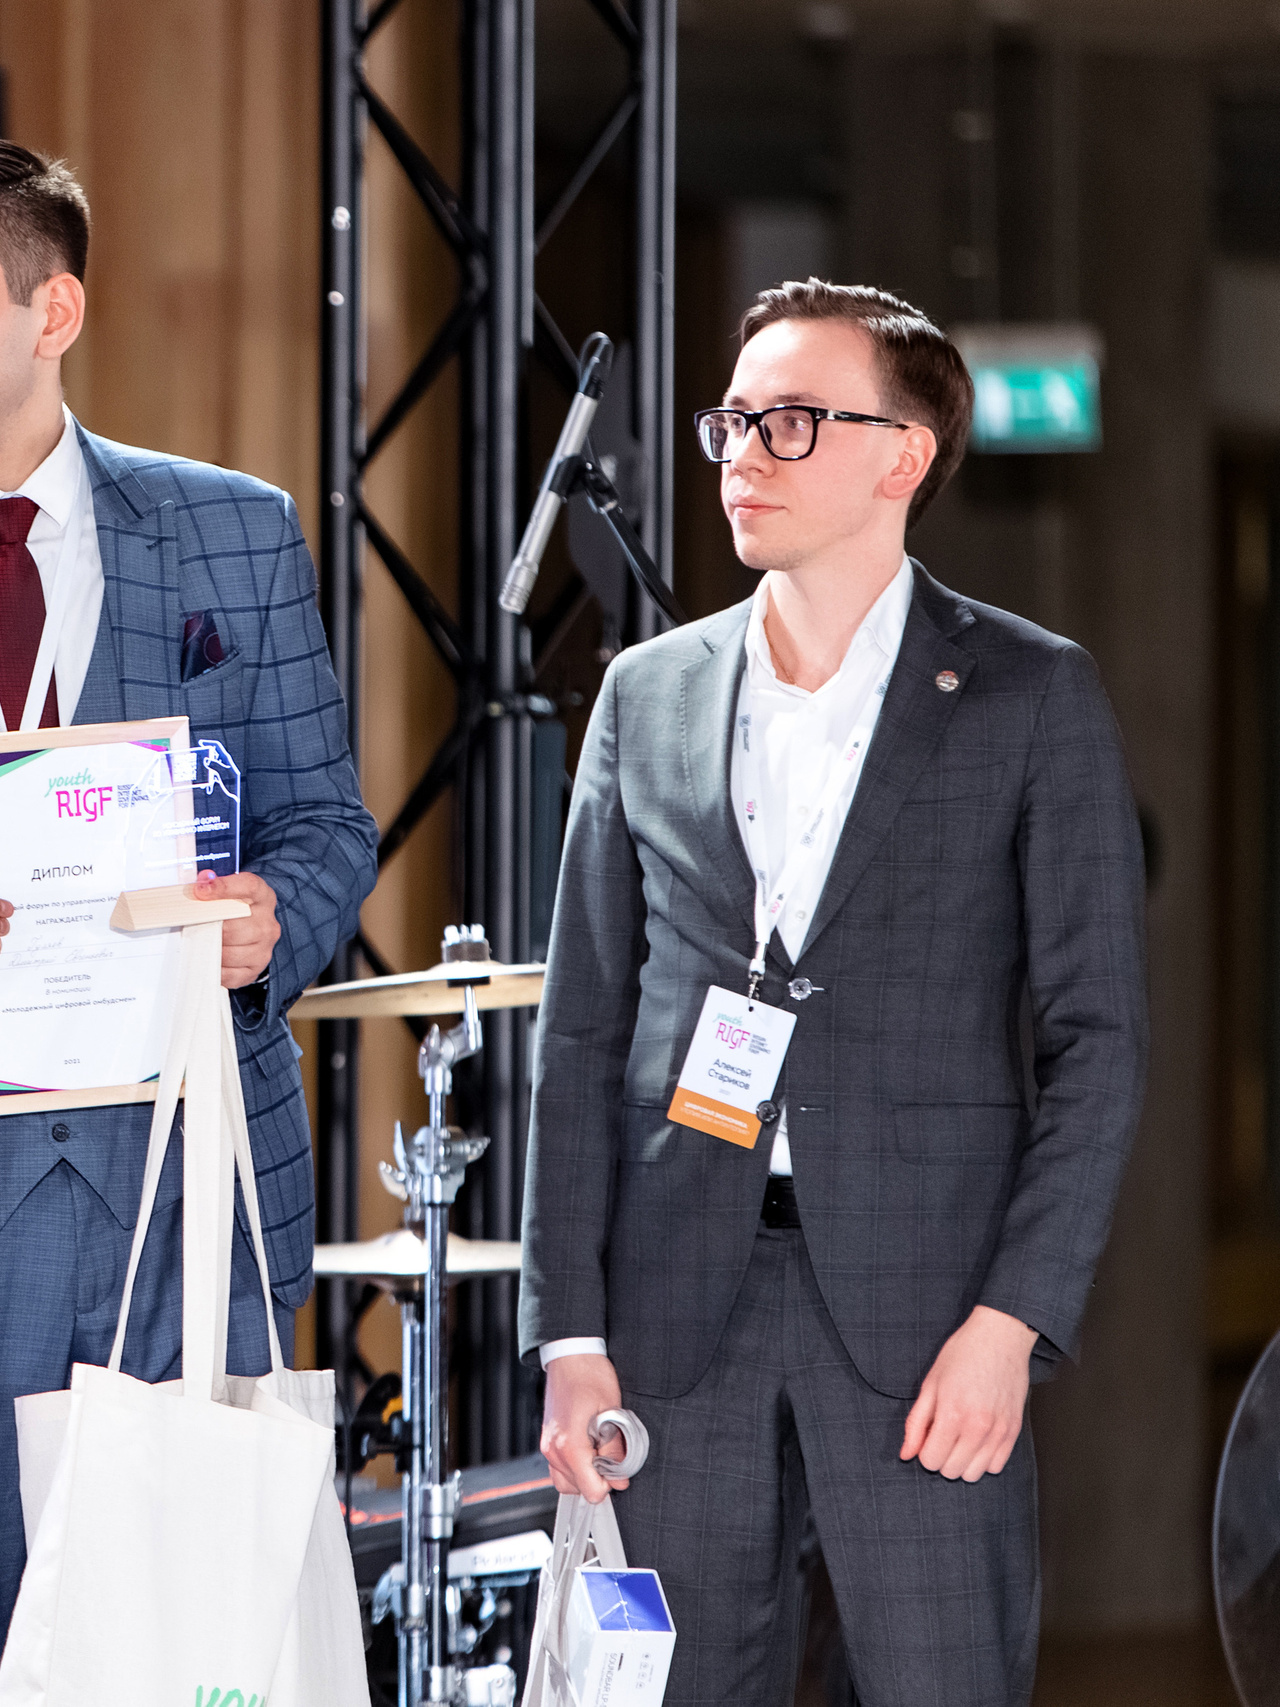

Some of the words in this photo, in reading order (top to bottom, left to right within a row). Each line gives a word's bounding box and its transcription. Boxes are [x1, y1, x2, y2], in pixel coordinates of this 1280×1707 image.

[44, 768, 95, 798] youth
[55, 786, 113, 822] RIGF
[31, 864, 93, 882] ДИПЛОМ
[26, 902, 50, 910] форум
[62, 897, 106, 907] управлению
[36, 914, 94, 925] НАГРАЖДАЕТСЯ
[44, 974, 91, 984] ПОБЕДИТЕЛЬ
[52, 986, 91, 994] номинации
[55, 999, 91, 1009] цифровой
[712, 1013, 743, 1027] youth
[715, 1022, 751, 1049] RIGF
[713, 1058, 752, 1078] Алексей
[708, 1068, 750, 1090] Стариков
